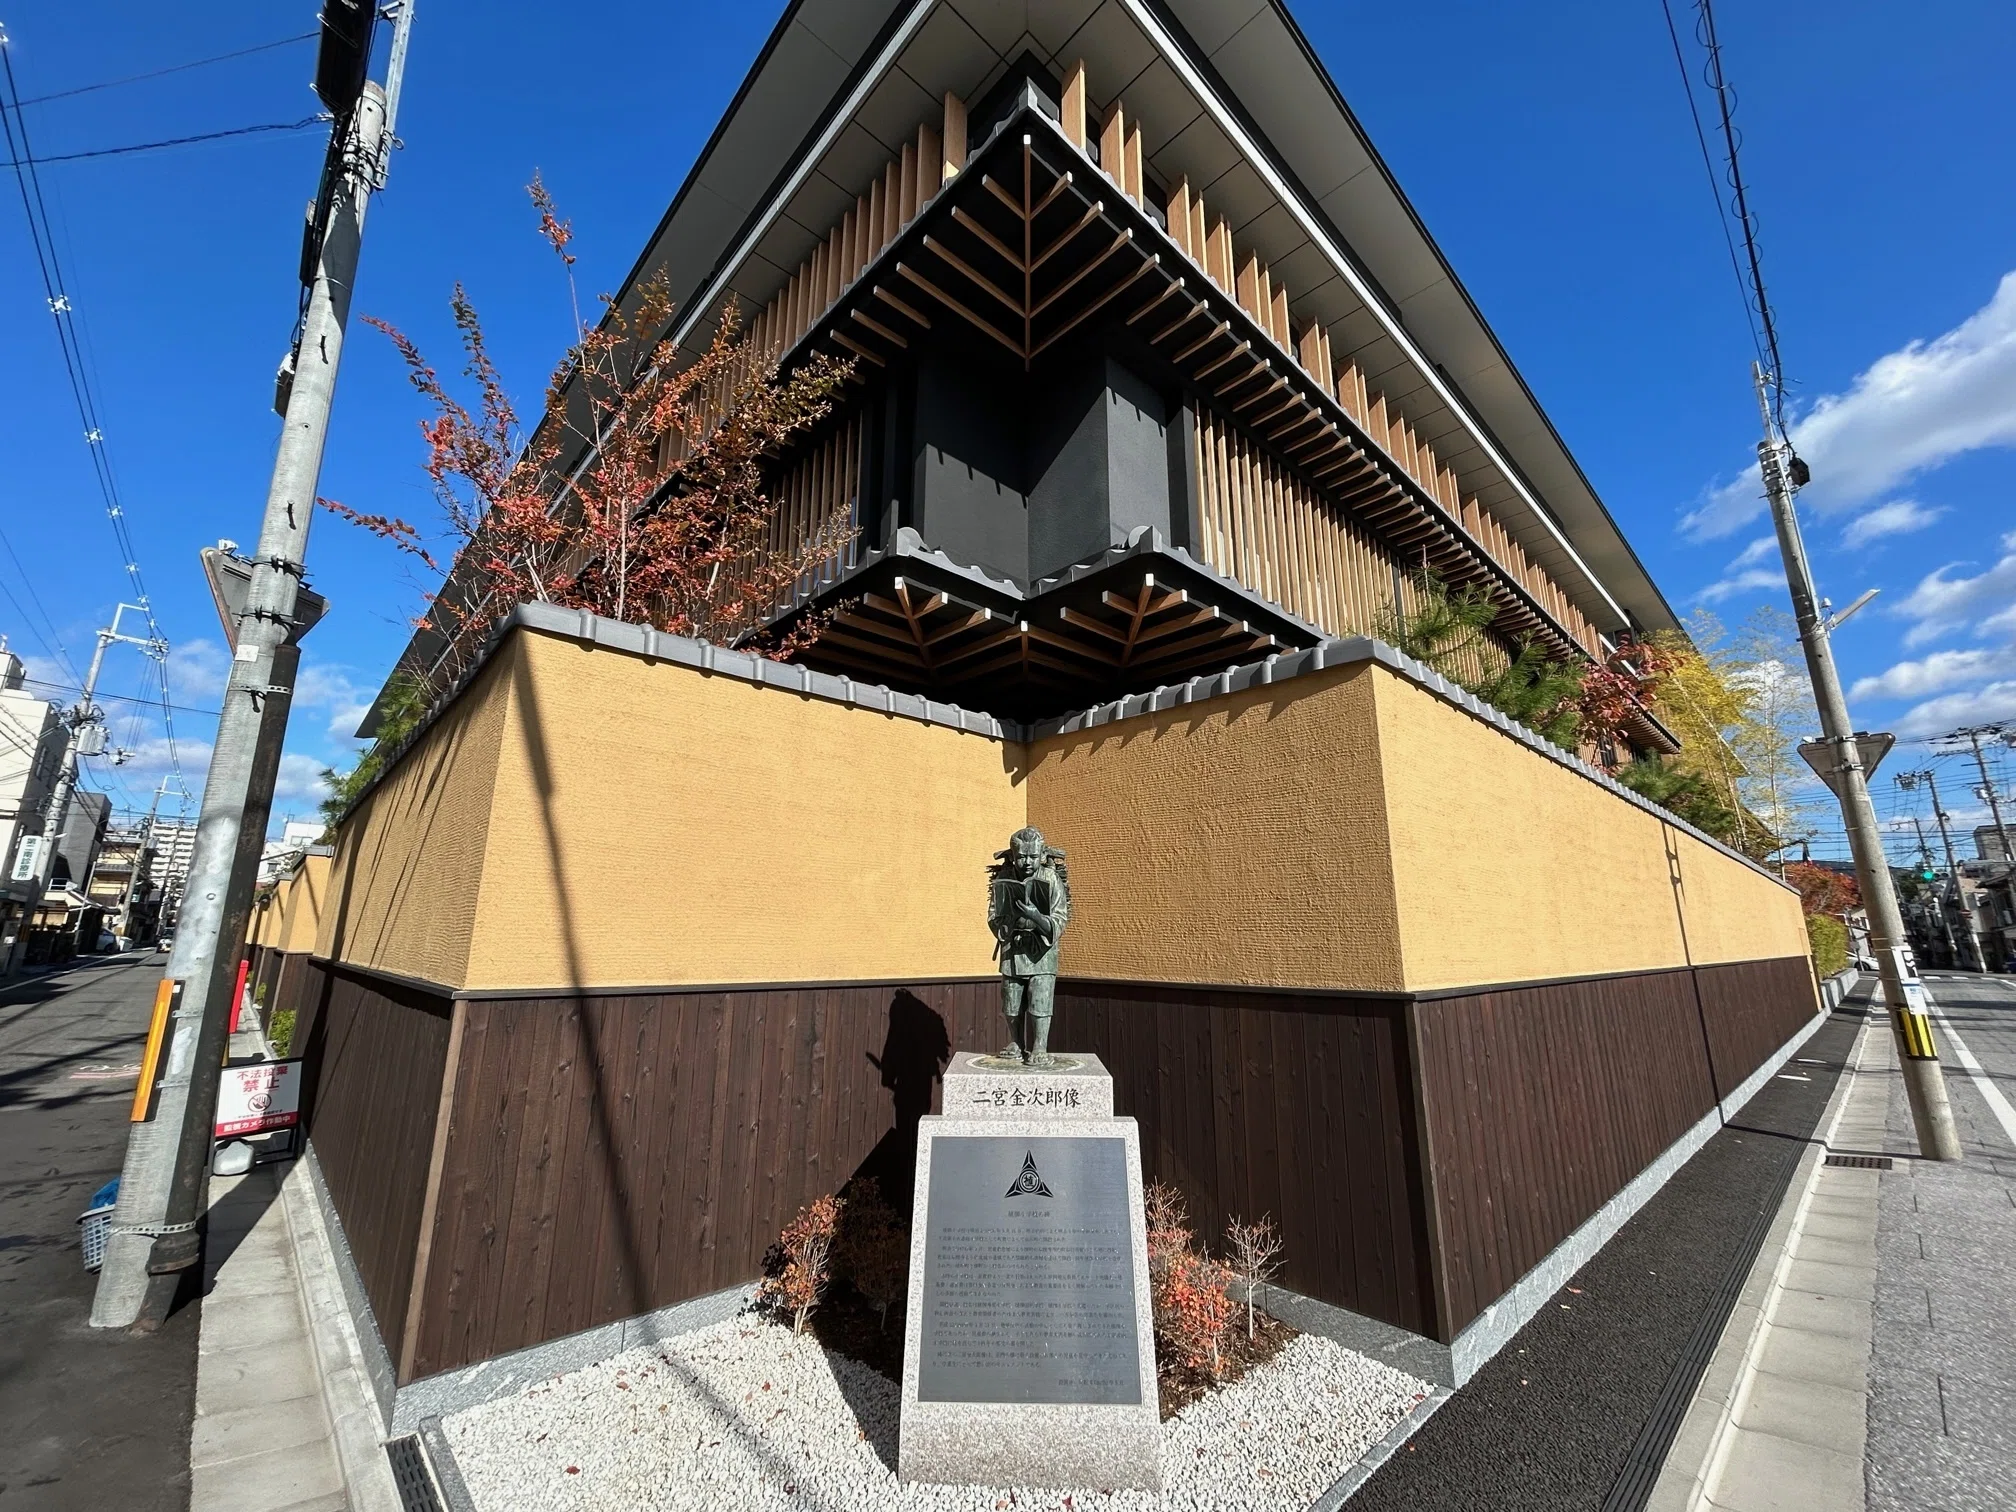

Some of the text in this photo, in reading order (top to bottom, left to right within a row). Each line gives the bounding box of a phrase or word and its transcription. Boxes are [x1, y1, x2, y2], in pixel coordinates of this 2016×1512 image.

[237, 1066, 288, 1080] 不法投棄
[243, 1077, 280, 1092] 禁止
[972, 1087, 1081, 1108] 二宮金次郎像
[224, 1115, 291, 1132] 監視カメラ作動中
